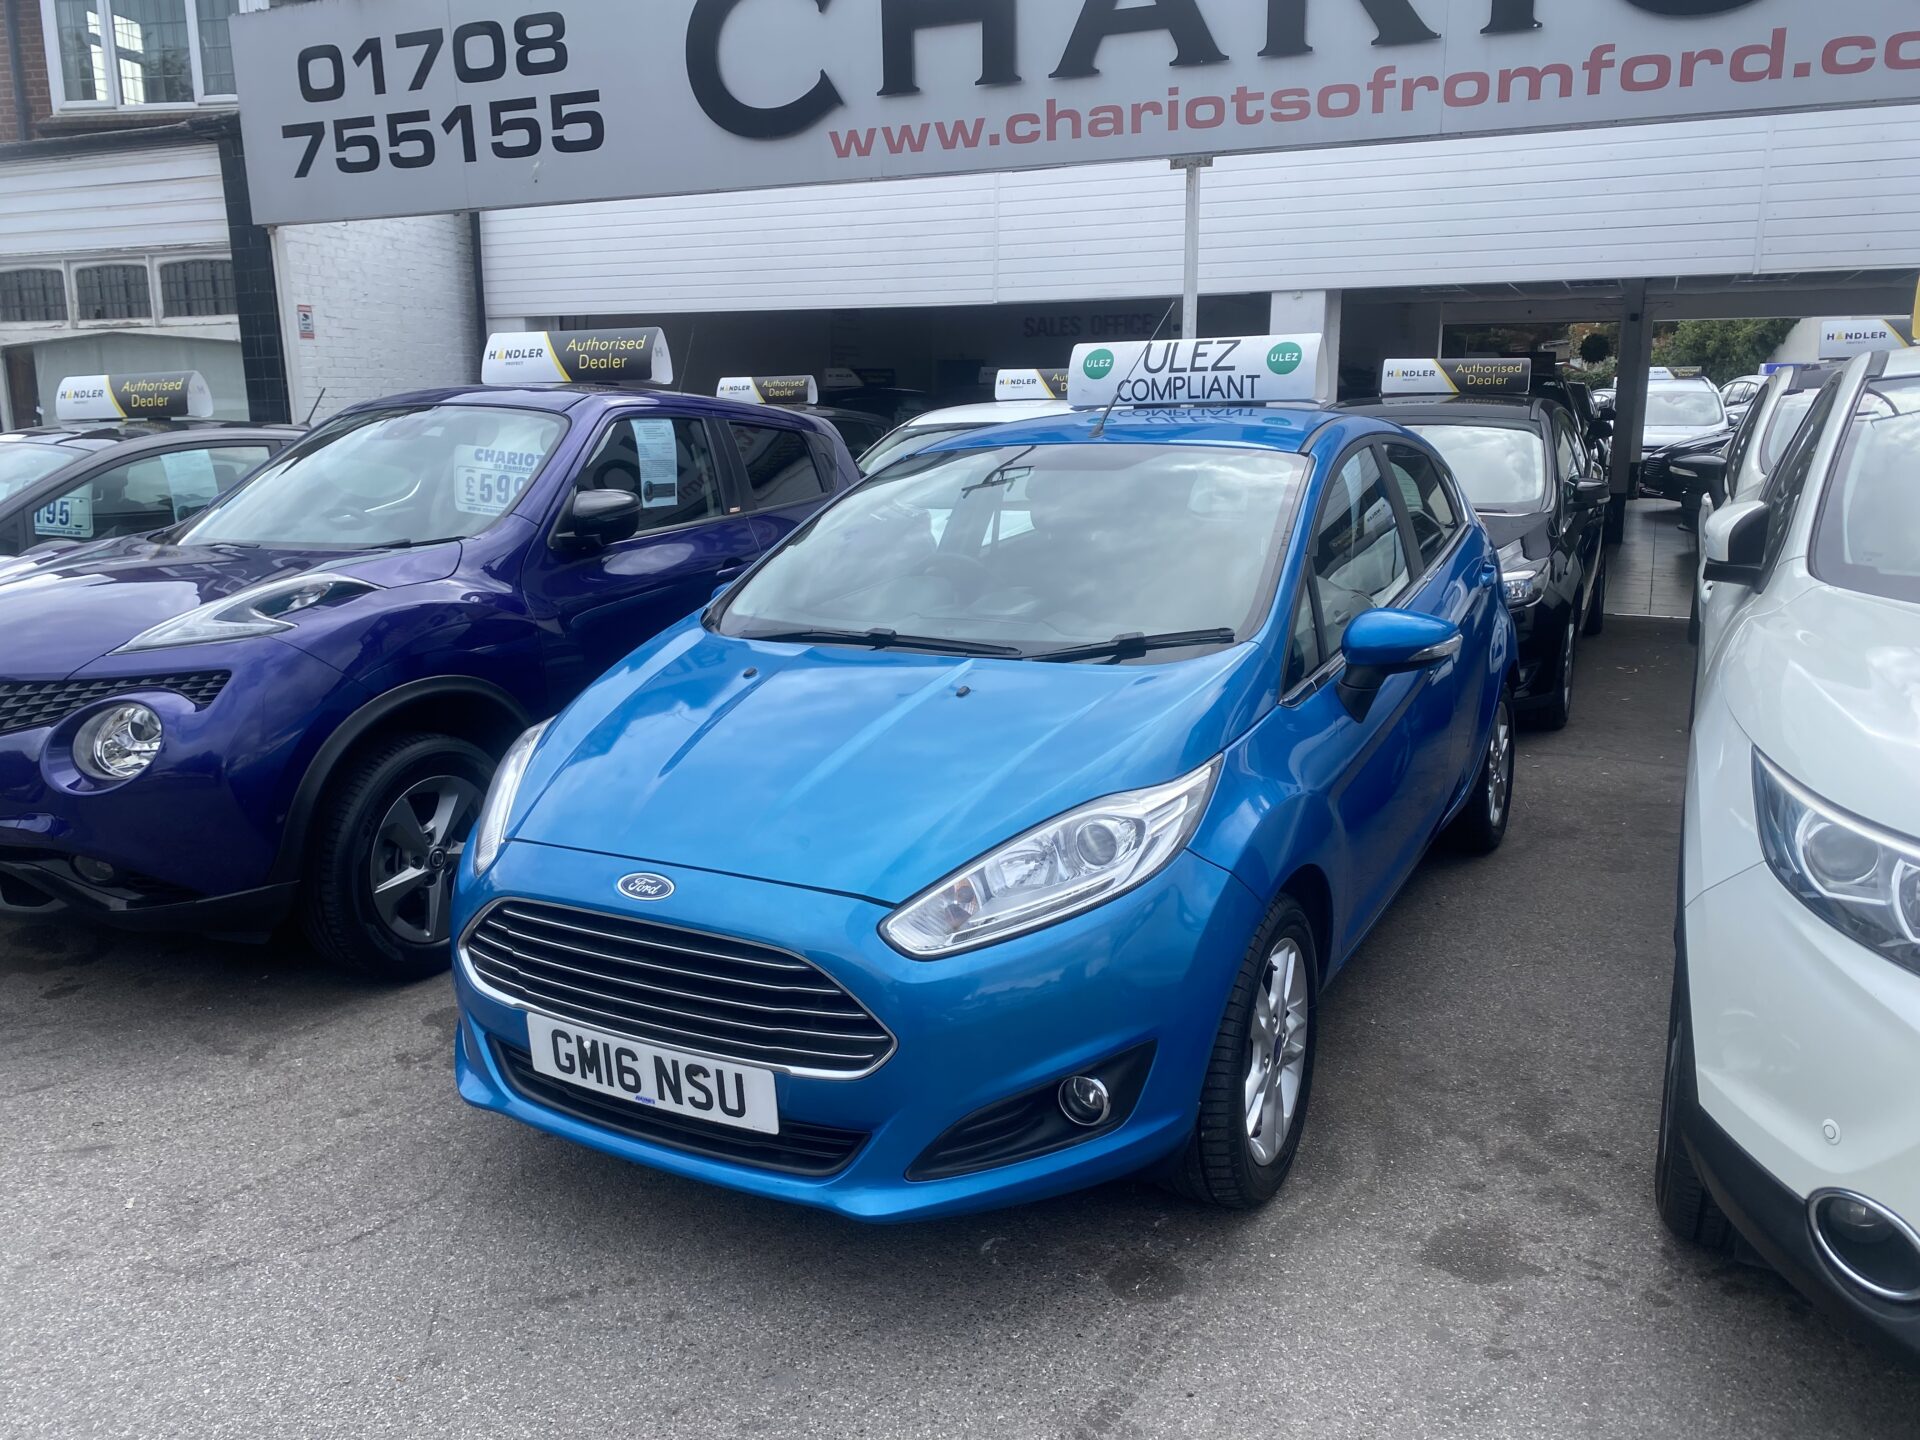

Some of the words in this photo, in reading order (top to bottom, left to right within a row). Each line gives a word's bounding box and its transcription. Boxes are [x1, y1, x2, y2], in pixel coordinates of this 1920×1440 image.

[297, 11, 568, 103] 01708
[281, 89, 605, 179] 755155
[1023, 315, 1081, 337] SALES
[1090, 313, 1151, 336] OFFICE
[566, 335, 647, 351] Authorised
[579, 353, 627, 369] Dealer
[1086, 359, 1112, 368] ULEZ
[1143, 339, 1242, 374] ULEZ
[1270, 353, 1299, 362] ULEZ
[1456, 363, 1523, 373] Authorised
[121, 377, 184, 392] Authorised
[762, 378, 805, 388] Authorised
[1467, 374, 1509, 385] Dealer
[768, 388, 795, 396] Dealer
[1117, 375, 1261, 402] COMPLIANT
[131, 393, 169, 407] Dealer
[628, 877, 662, 895] Ford
[551, 1029, 642, 1094] GM16
[653, 1055, 747, 1118] NSU
